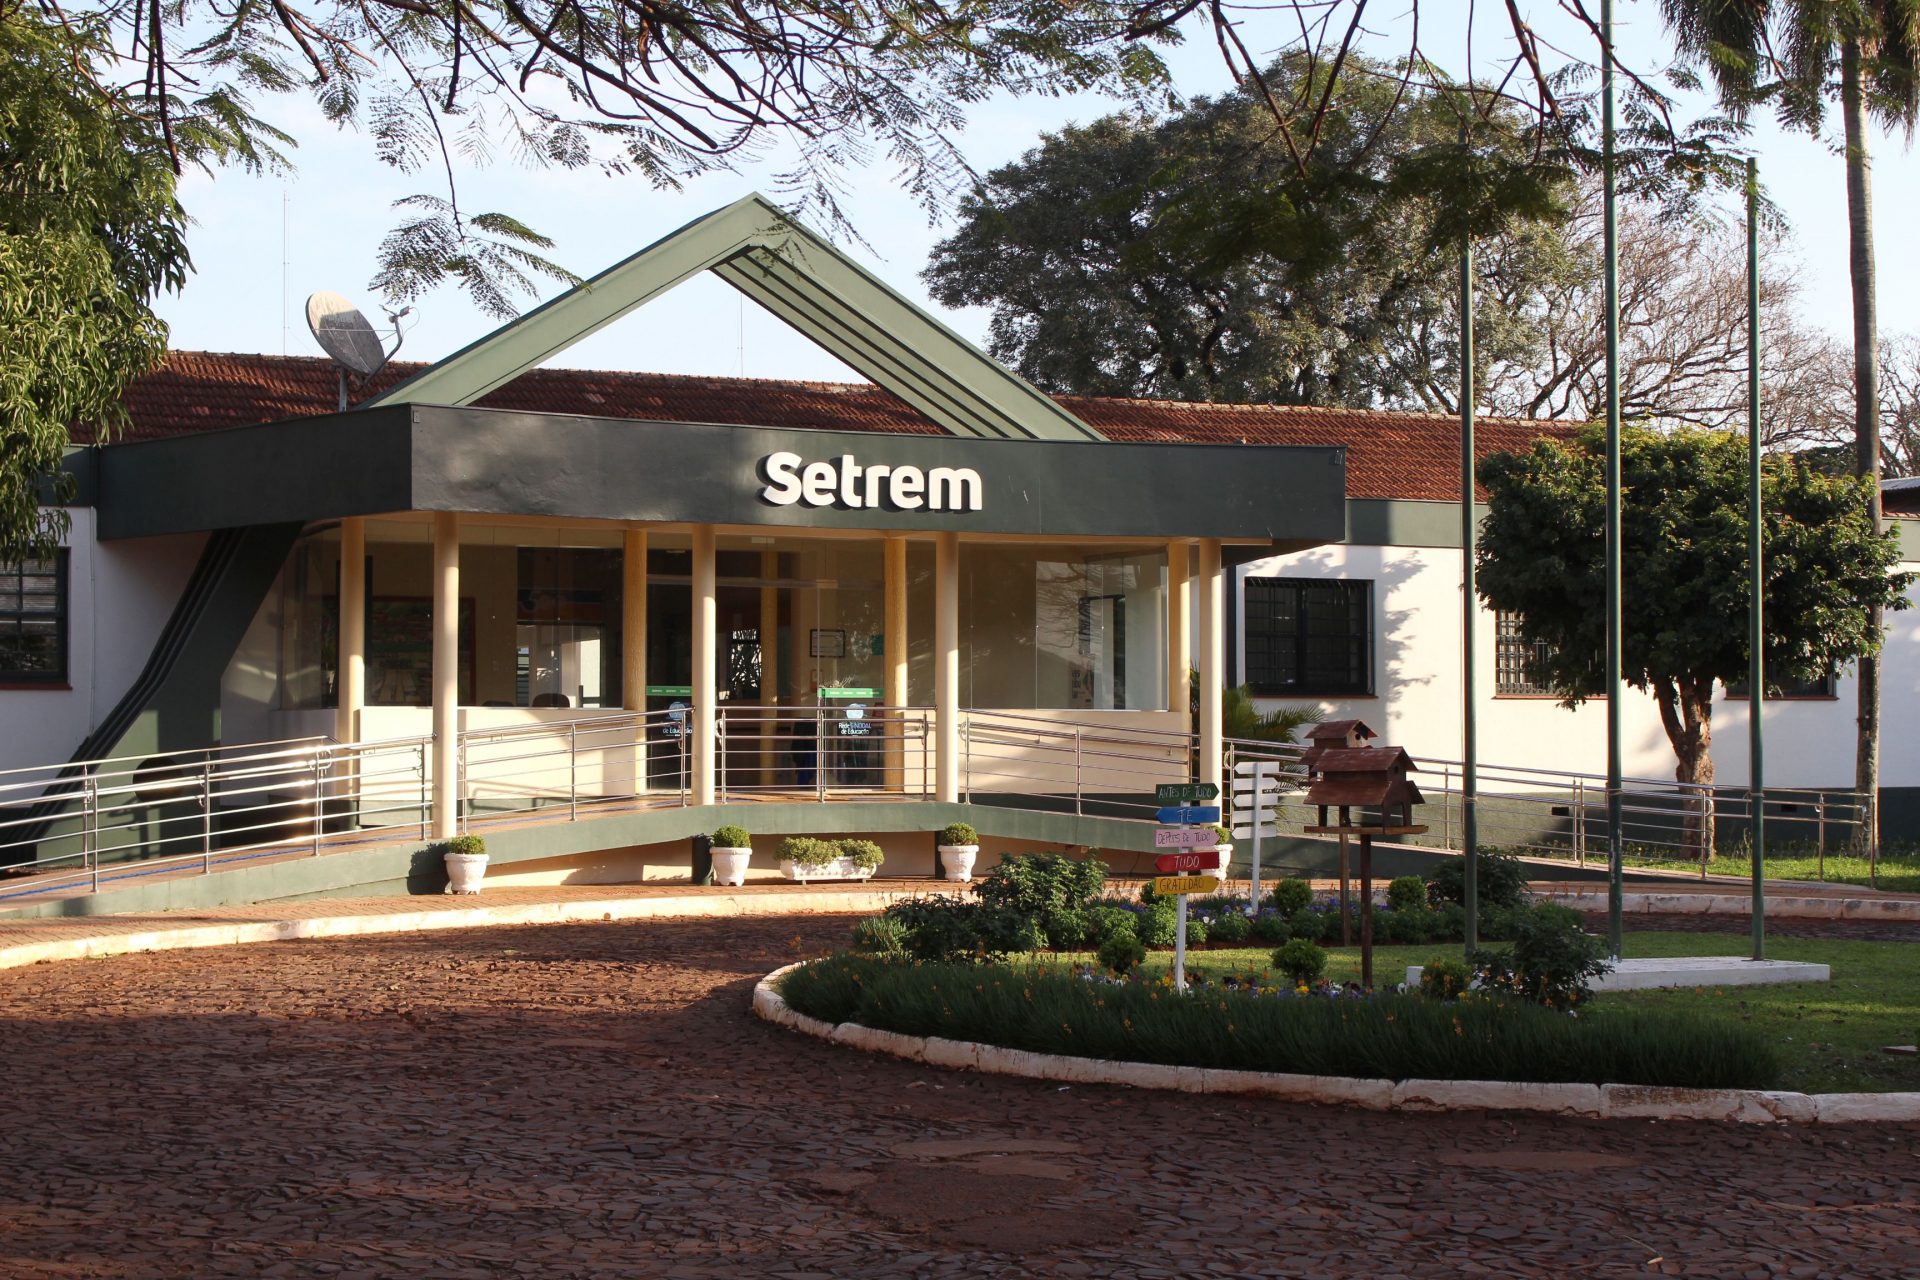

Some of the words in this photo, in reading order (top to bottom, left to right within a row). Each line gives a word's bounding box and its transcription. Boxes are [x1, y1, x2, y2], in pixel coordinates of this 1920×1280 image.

[763, 451, 983, 511] Setrem
[1158, 786, 1180, 799] ANTES
[1194, 785, 1212, 799] TUDO
[1193, 832, 1211, 843] TUDO
[1174, 855, 1200, 869] TUDO
